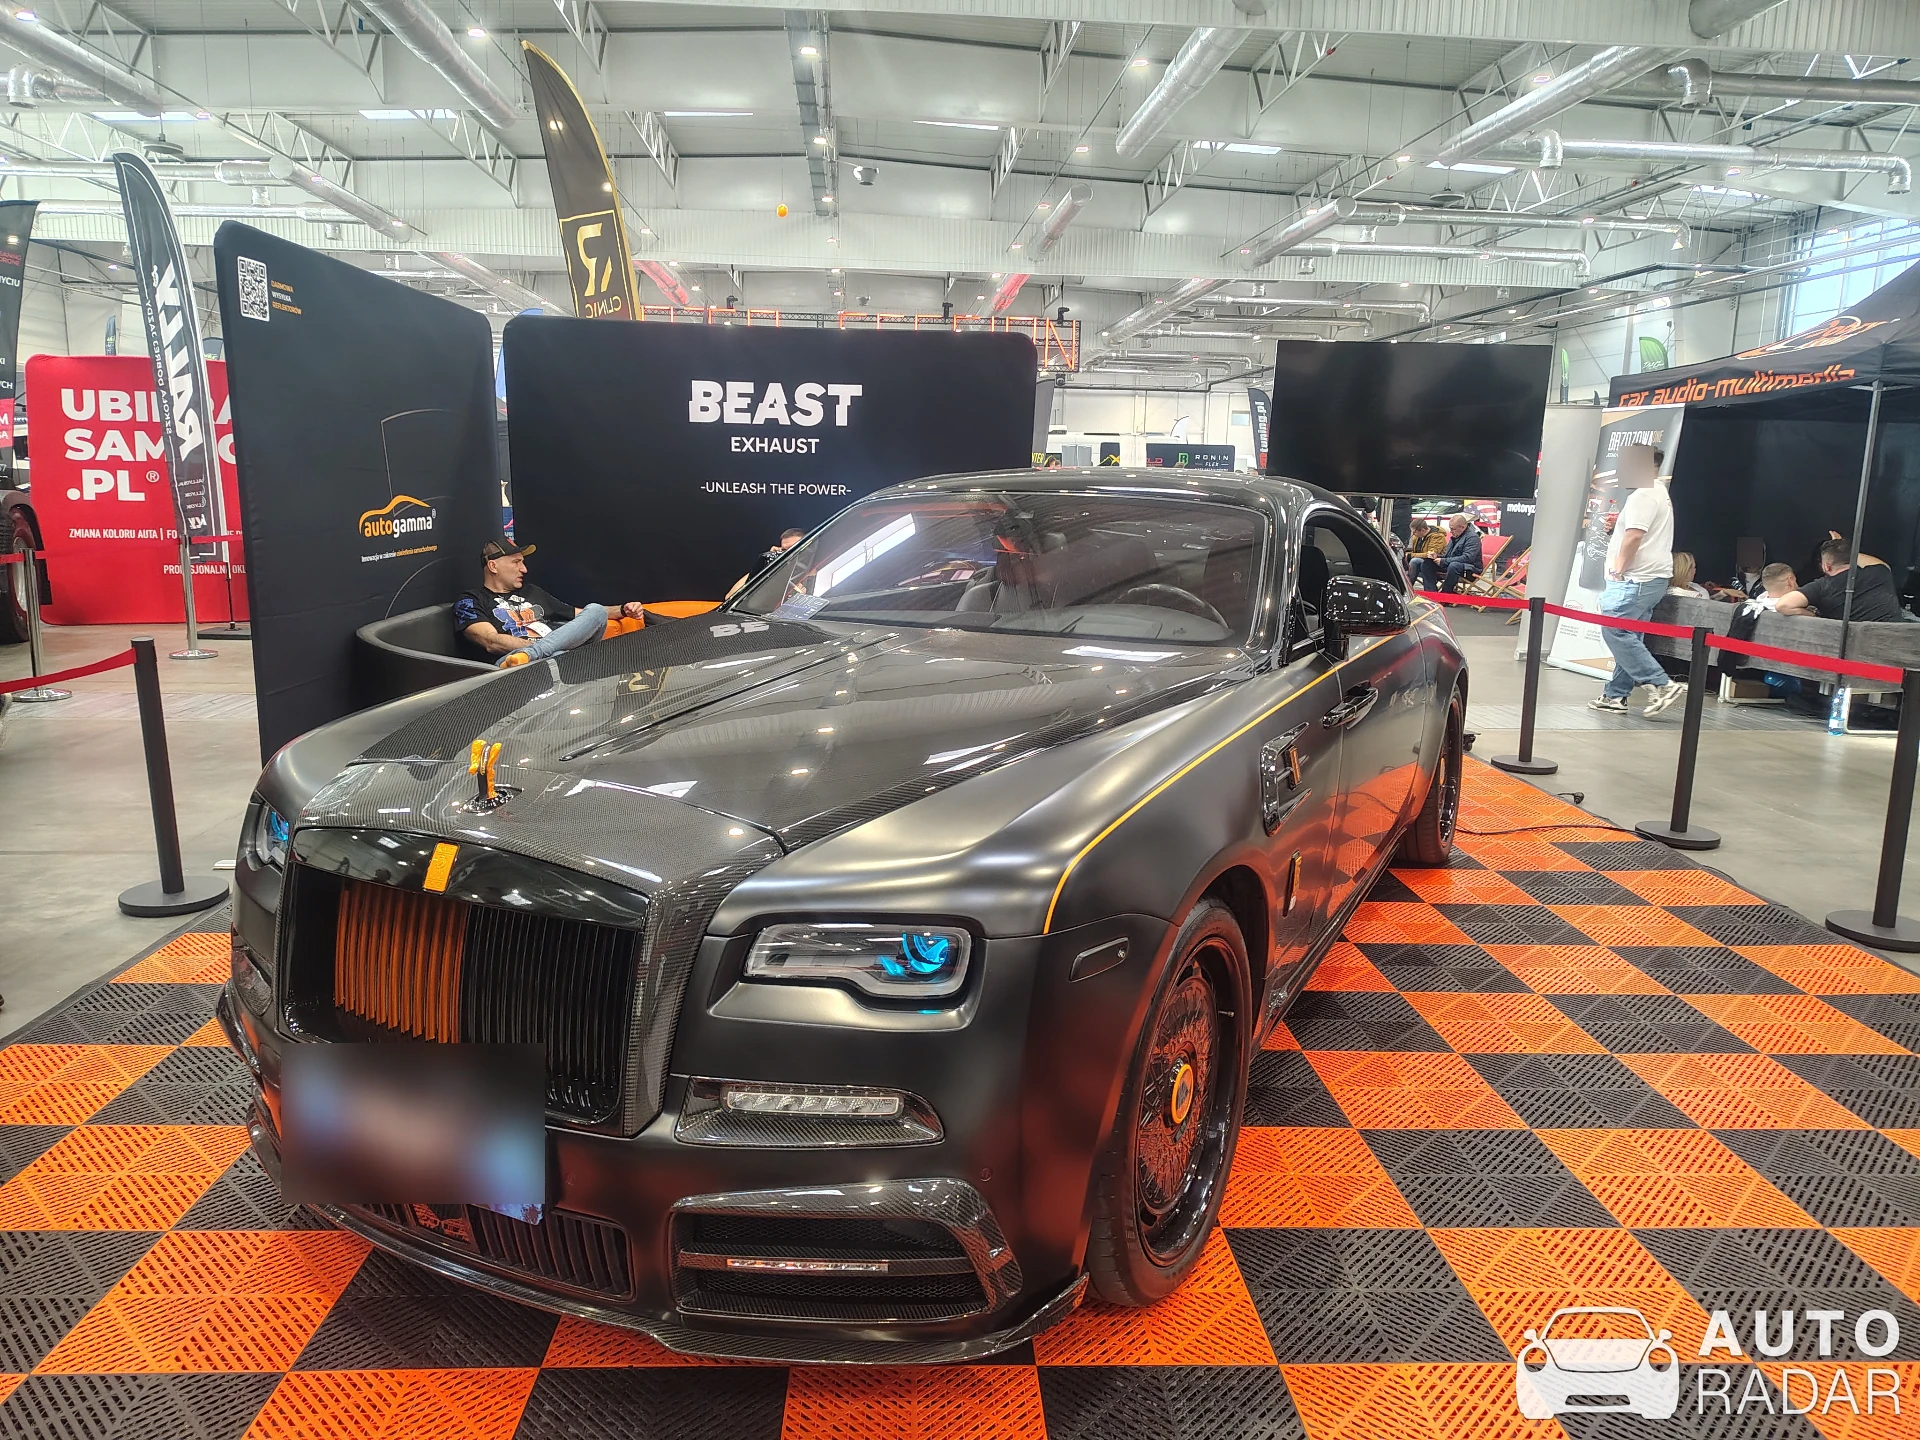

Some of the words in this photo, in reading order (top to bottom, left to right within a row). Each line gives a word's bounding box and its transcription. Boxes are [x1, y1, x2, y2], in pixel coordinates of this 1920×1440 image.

[688, 380, 863, 427] BEAST
[1619, 391, 1649, 407] car
[731, 436, 820, 454] EXHAUST
[770, 484, 795, 495] THE
[69, 528, 101, 539] ZMIANA
[102, 528, 136, 539] KOLORU
[137, 529, 158, 540] AUTA
